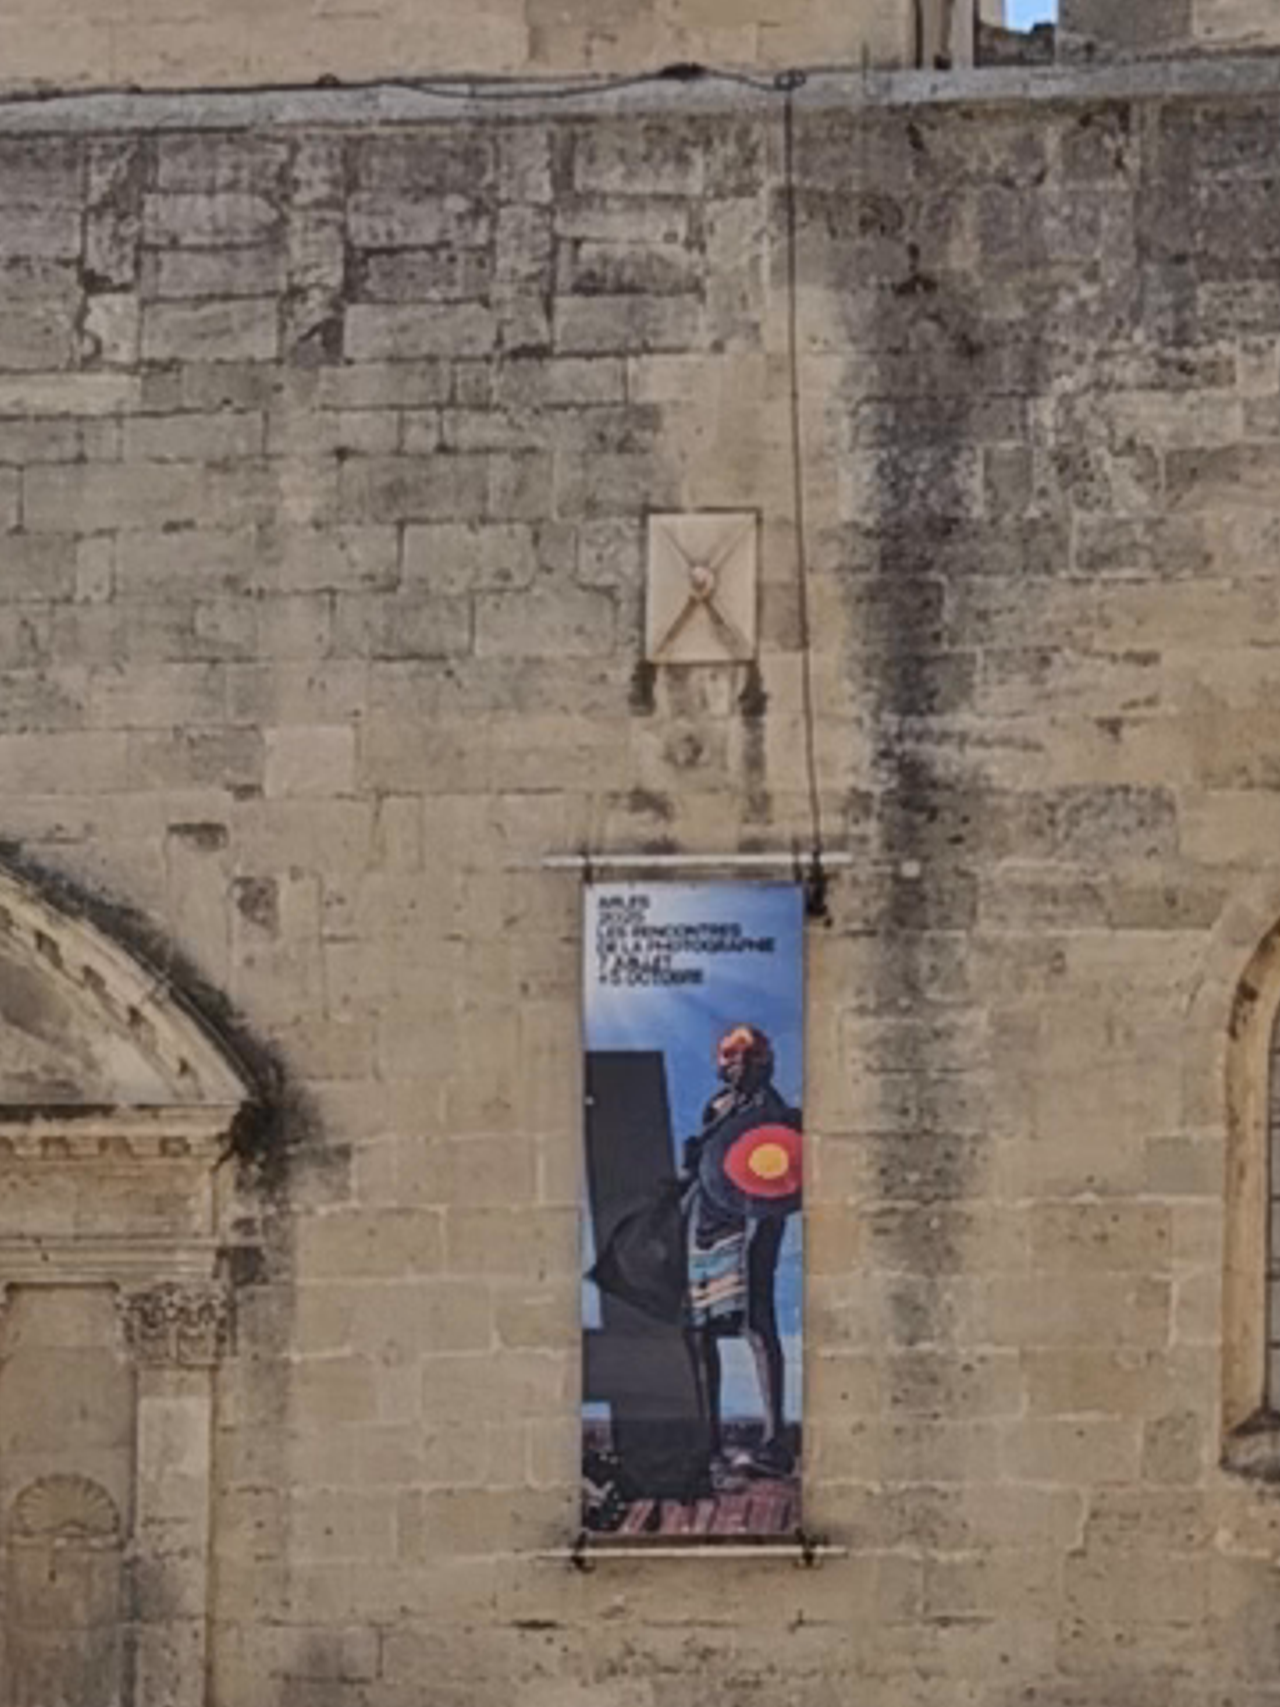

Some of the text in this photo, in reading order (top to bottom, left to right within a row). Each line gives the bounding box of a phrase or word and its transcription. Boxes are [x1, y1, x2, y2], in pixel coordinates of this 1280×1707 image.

[599, 896, 650, 909] ARLES
[597, 923, 742, 938] LES RENCONTRES
[646, 937, 776, 953] PHOTOGRAPHIE
